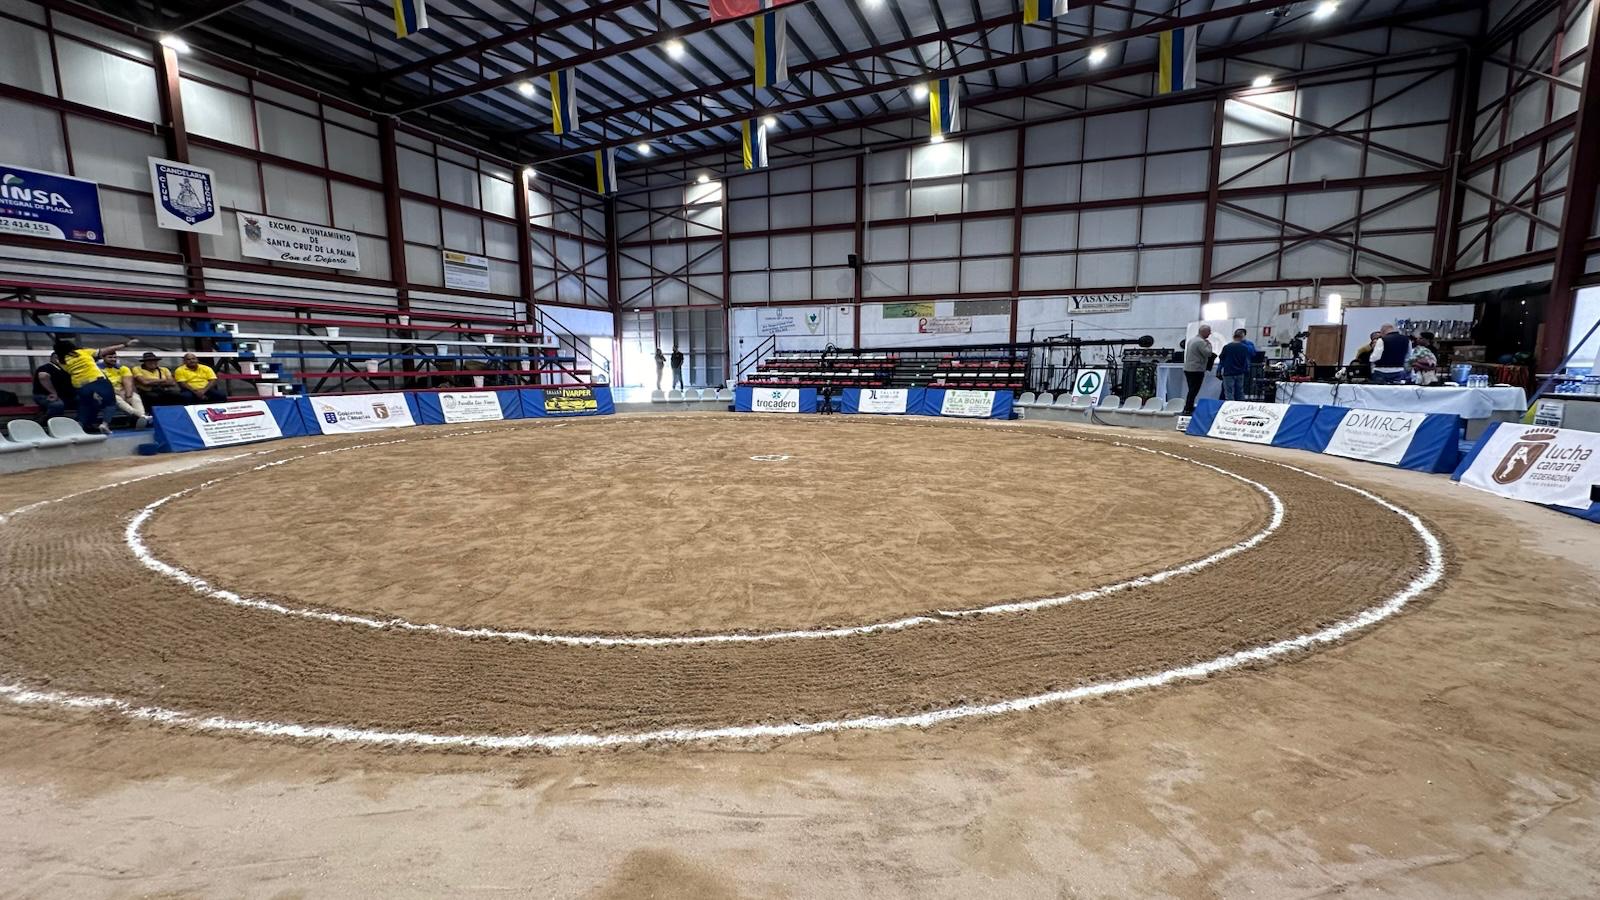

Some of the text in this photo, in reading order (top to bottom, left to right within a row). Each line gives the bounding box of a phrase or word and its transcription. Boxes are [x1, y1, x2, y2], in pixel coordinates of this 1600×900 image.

[160, 166, 207, 180] CANDELARIA
[159, 176, 168, 201] CLUB
[204, 181, 212, 212] LUCHAS
[46, 205, 74, 215] PLAGAS
[12, 221, 30, 229] 414
[33, 223, 50, 231] 151
[269, 221, 351, 241] EXCMO. AYUNTAMIENTO
[309, 236, 319, 244] DE
[267, 238, 291, 248] SANTA
[293, 242, 312, 251] CRUZ
[315, 244, 324, 253] DE
[336, 249, 356, 258] PALMA
[280, 252, 347, 264] Con el Deporte
[756, 398, 797, 408] trocadero
[1545, 443, 1593, 461] lucha
[1536, 460, 1582, 473] canaria
